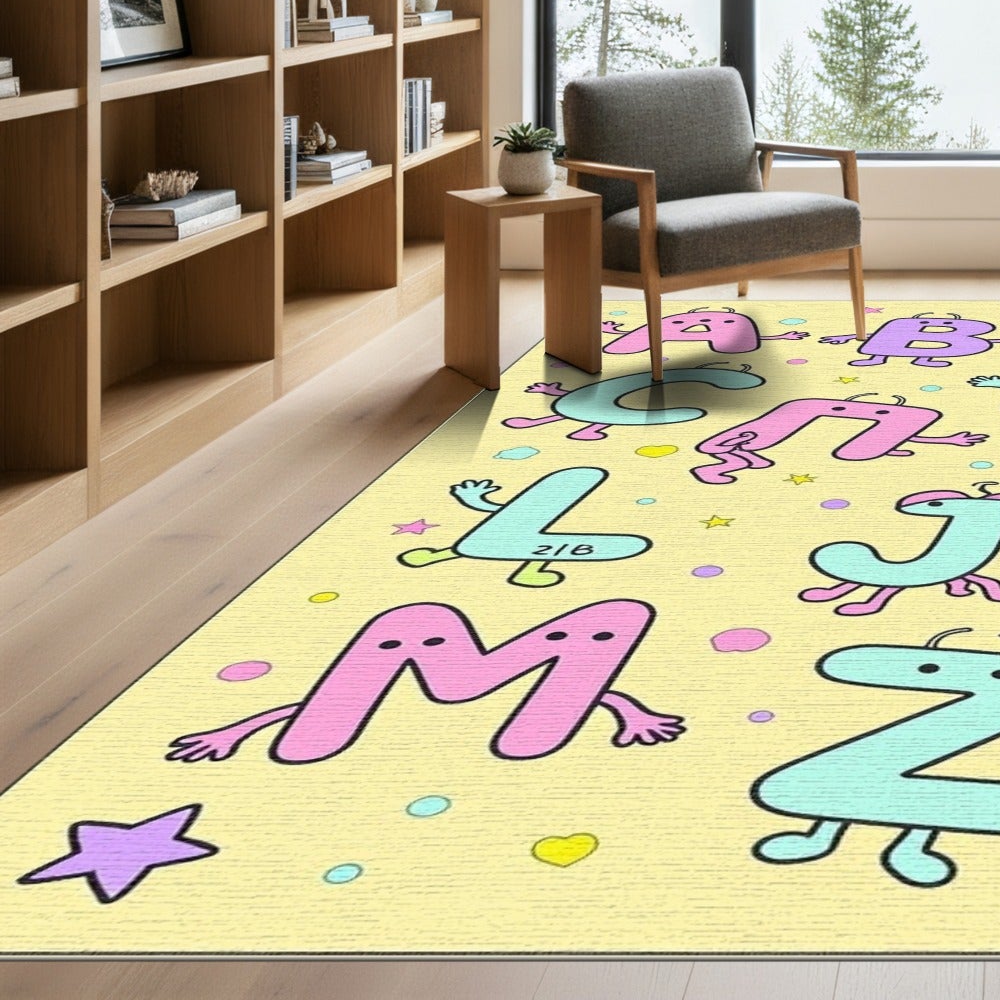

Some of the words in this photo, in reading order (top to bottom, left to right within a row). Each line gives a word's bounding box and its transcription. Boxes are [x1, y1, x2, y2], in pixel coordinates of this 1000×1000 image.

[602, 311, 761, 354] A
[857, 318, 996, 357] B
[550, 368, 766, 425] C
[451, 466, 653, 562] L
[268, 598, 656, 765] M
